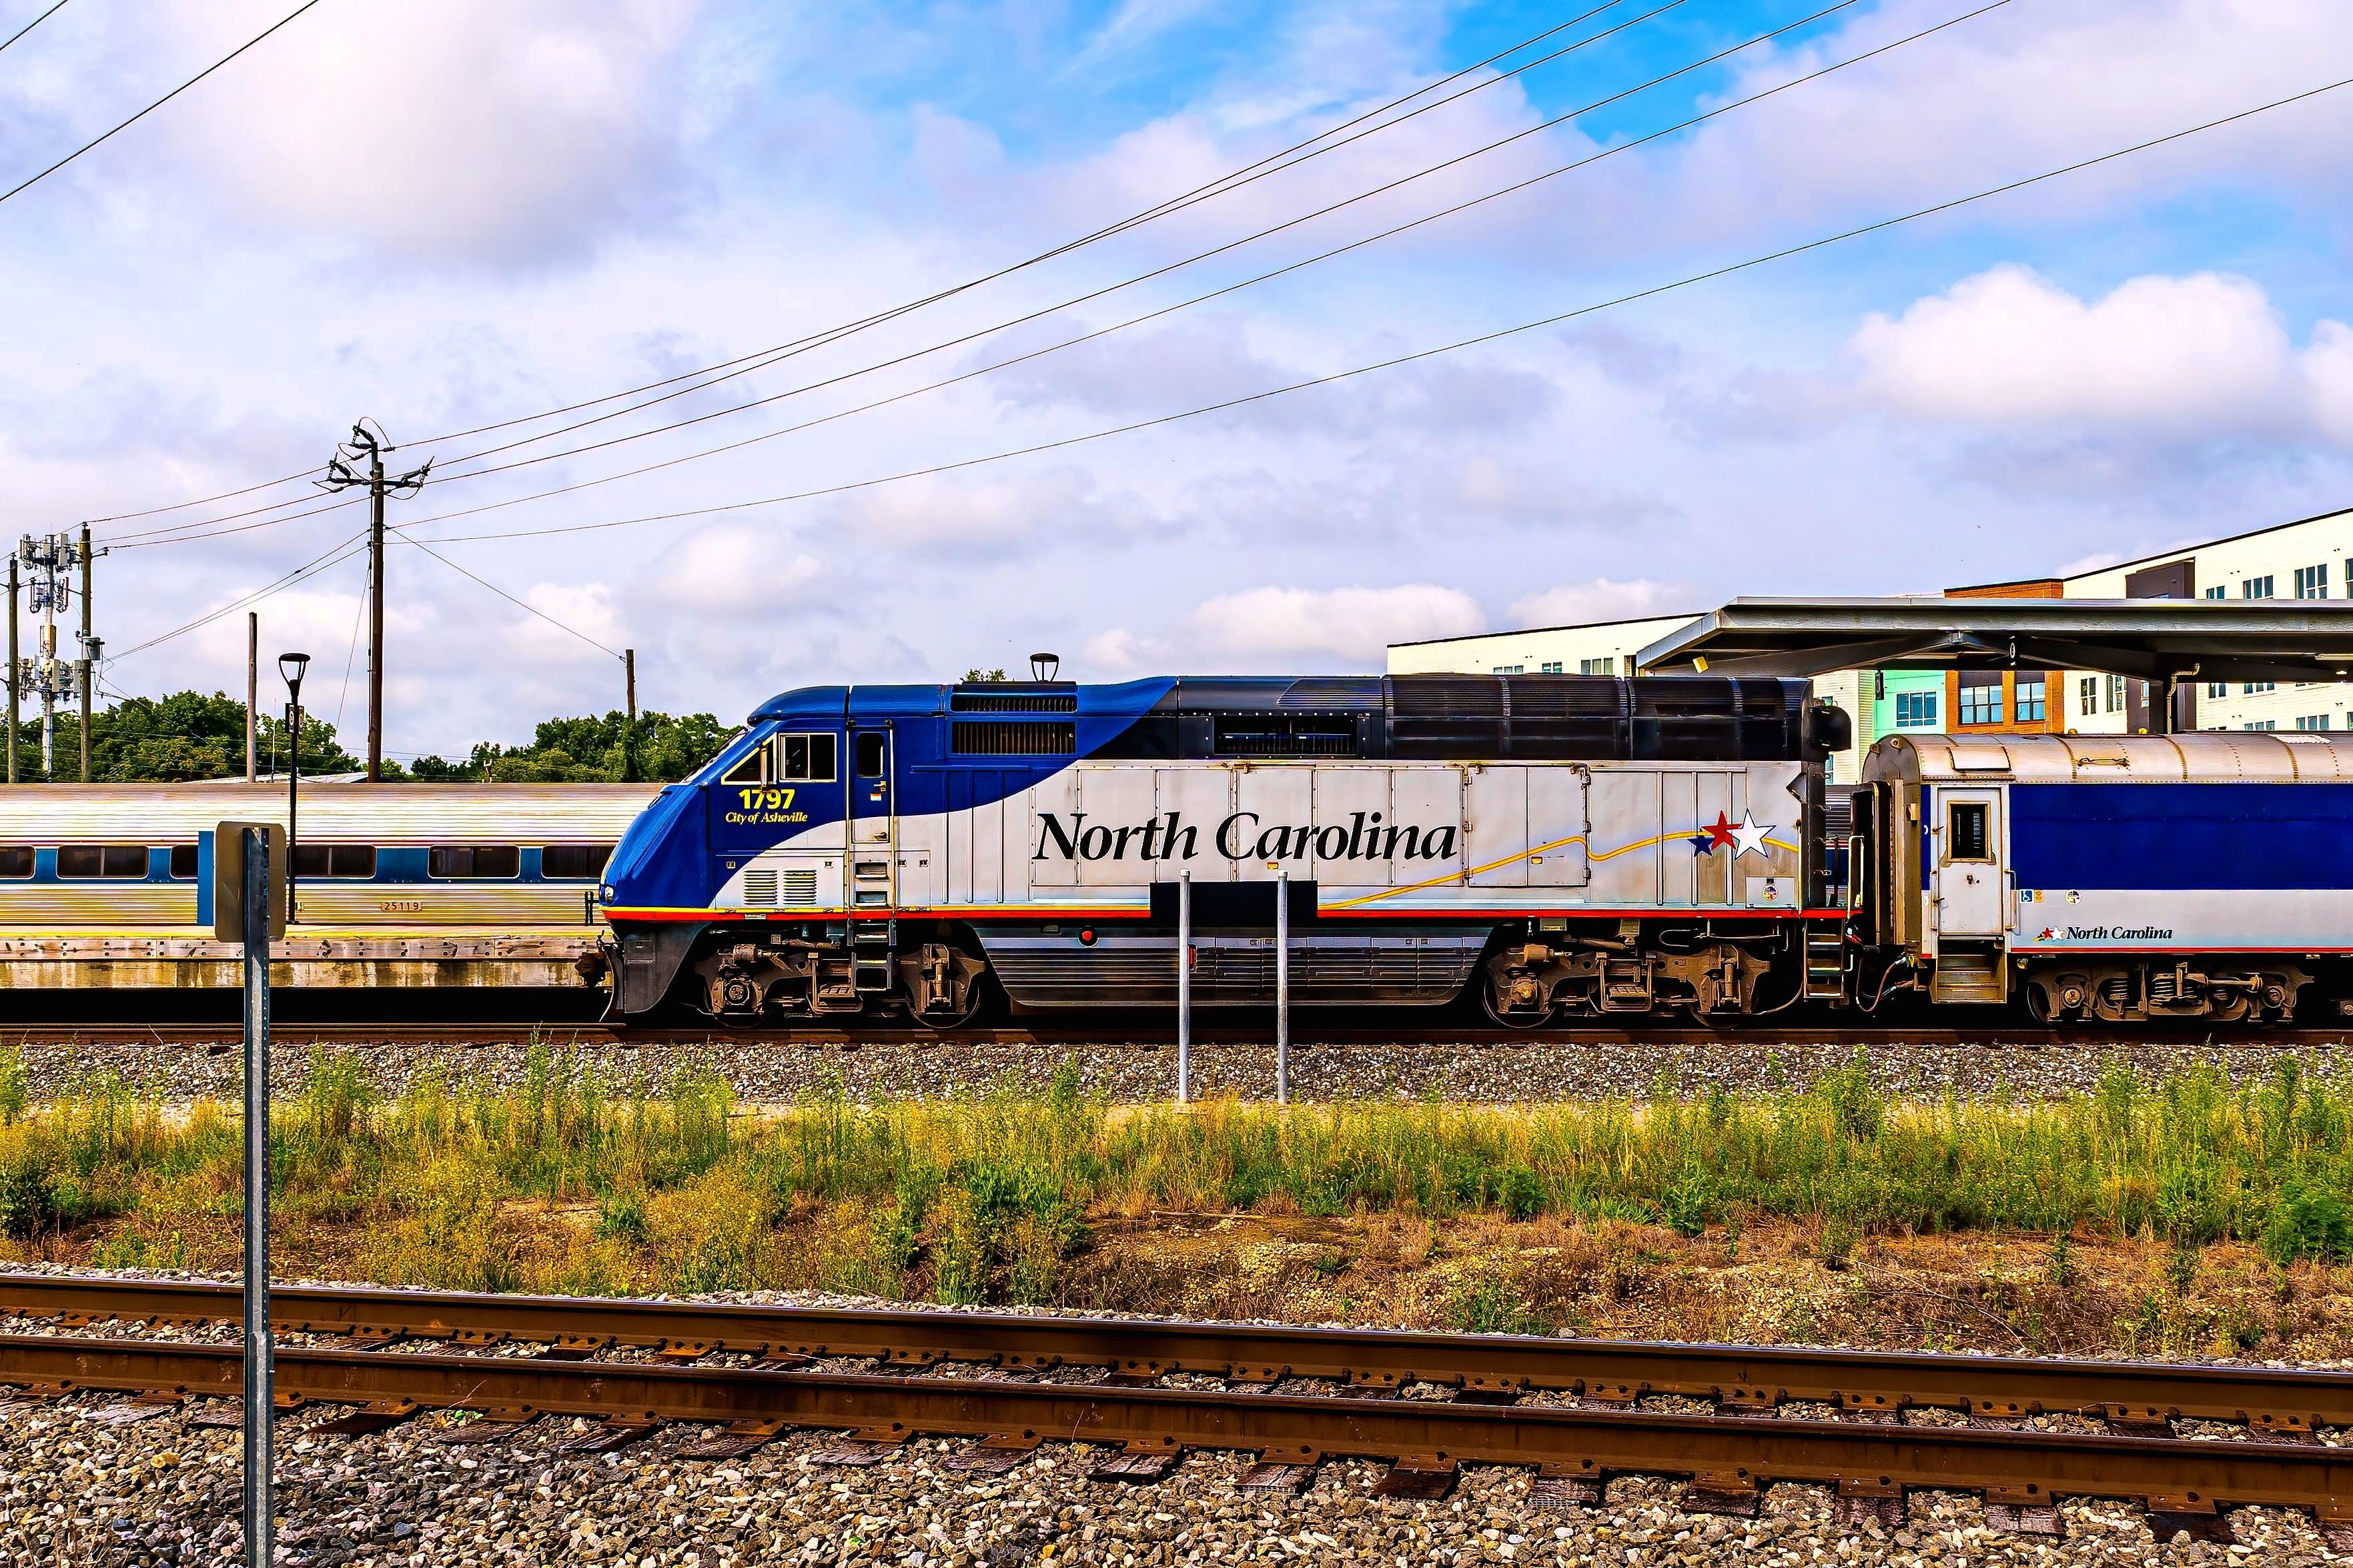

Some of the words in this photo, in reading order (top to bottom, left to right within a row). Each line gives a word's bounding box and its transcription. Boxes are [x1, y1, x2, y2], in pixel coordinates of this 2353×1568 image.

[739, 789, 795, 809] 1797
[725, 812, 747, 825] City
[747, 812, 761, 825] of
[761, 812, 808, 823] Asheville
[1031, 812, 1199, 861] North
[1216, 811, 1458, 861] Carolina
[384, 902, 419, 910] 25119
[2066, 926, 2108, 940] North
[2111, 926, 2173, 940] Carolina
